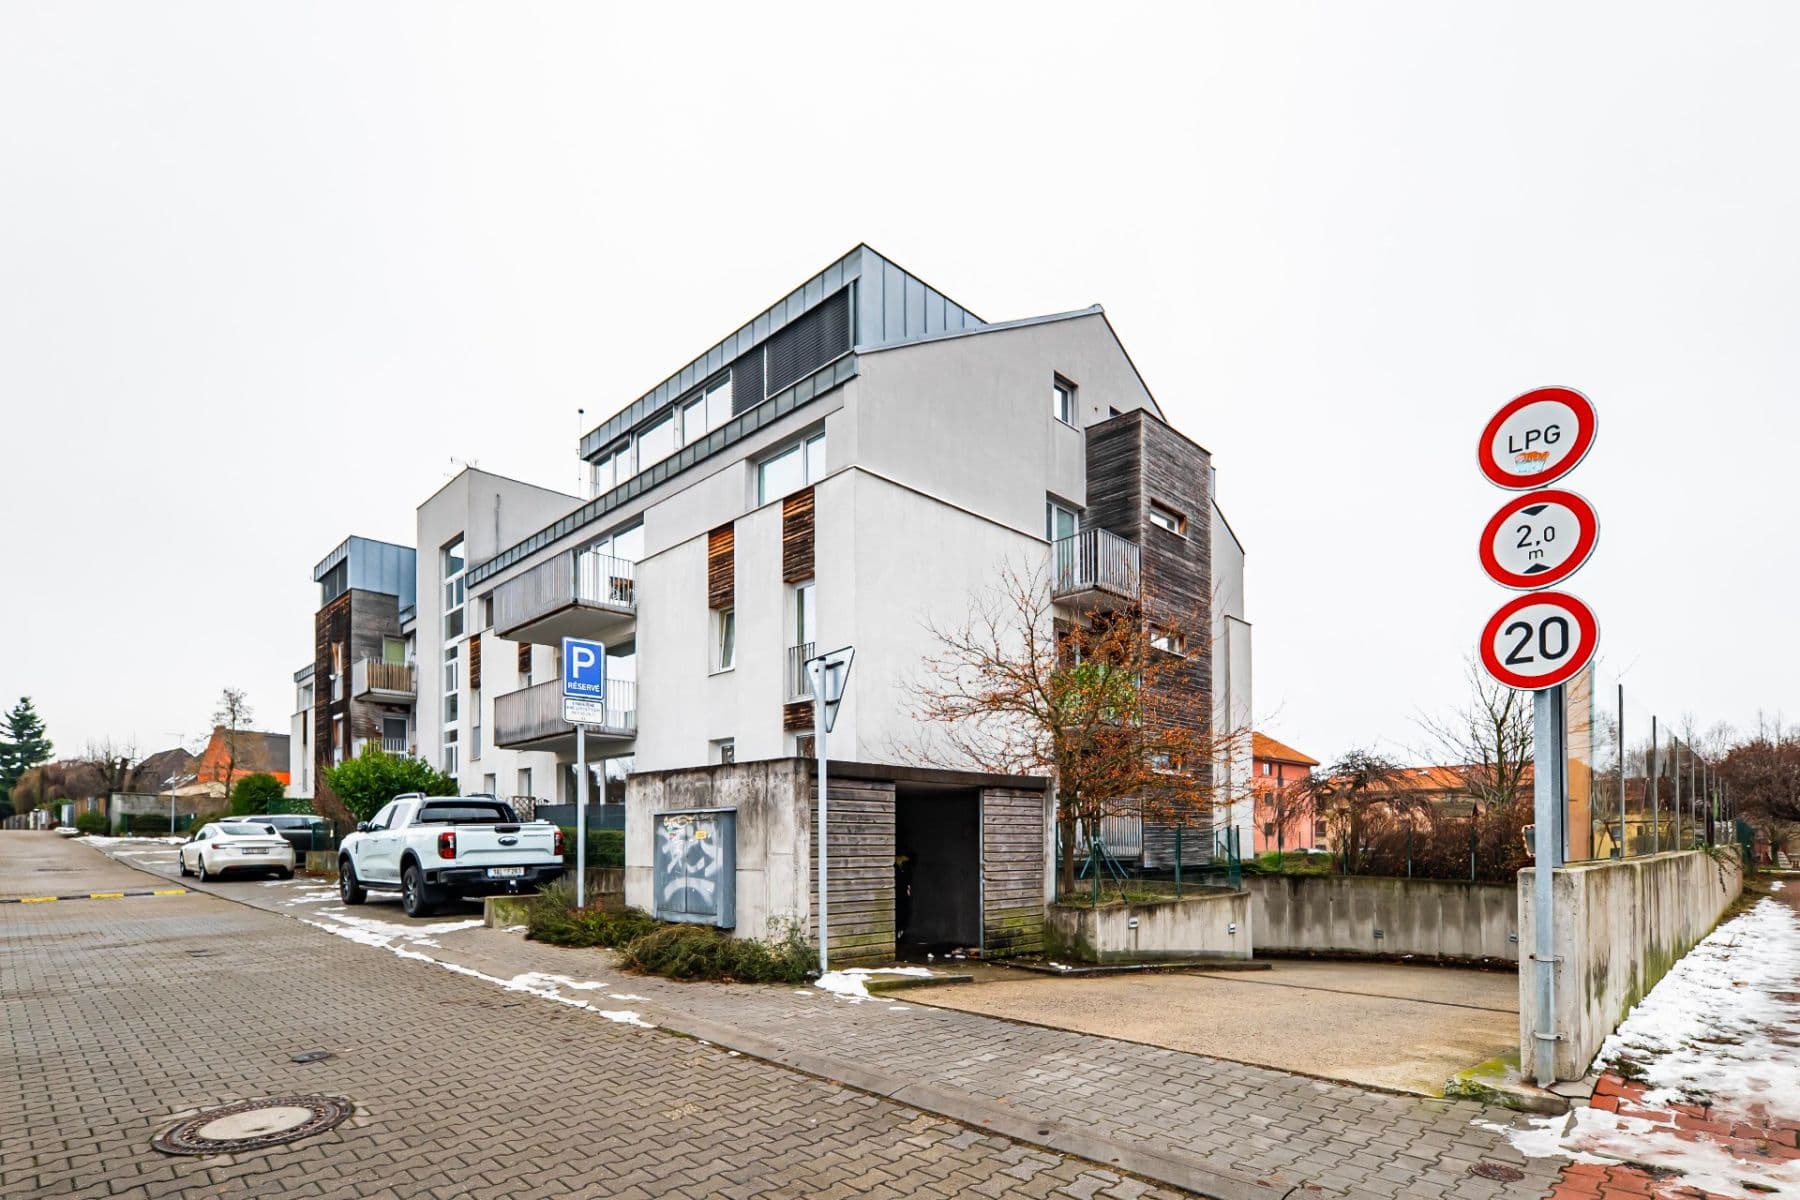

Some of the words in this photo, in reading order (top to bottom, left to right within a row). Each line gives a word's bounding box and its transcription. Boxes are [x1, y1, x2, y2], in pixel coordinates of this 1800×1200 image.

[1508, 424, 1560, 454] LPG
[1516, 525, 1555, 549] 2,0
[1528, 548, 1544, 560] m
[1504, 616, 1569, 666] 20
[572, 646, 595, 679] P
[567, 681, 601, 693] RÉSERVÉ
